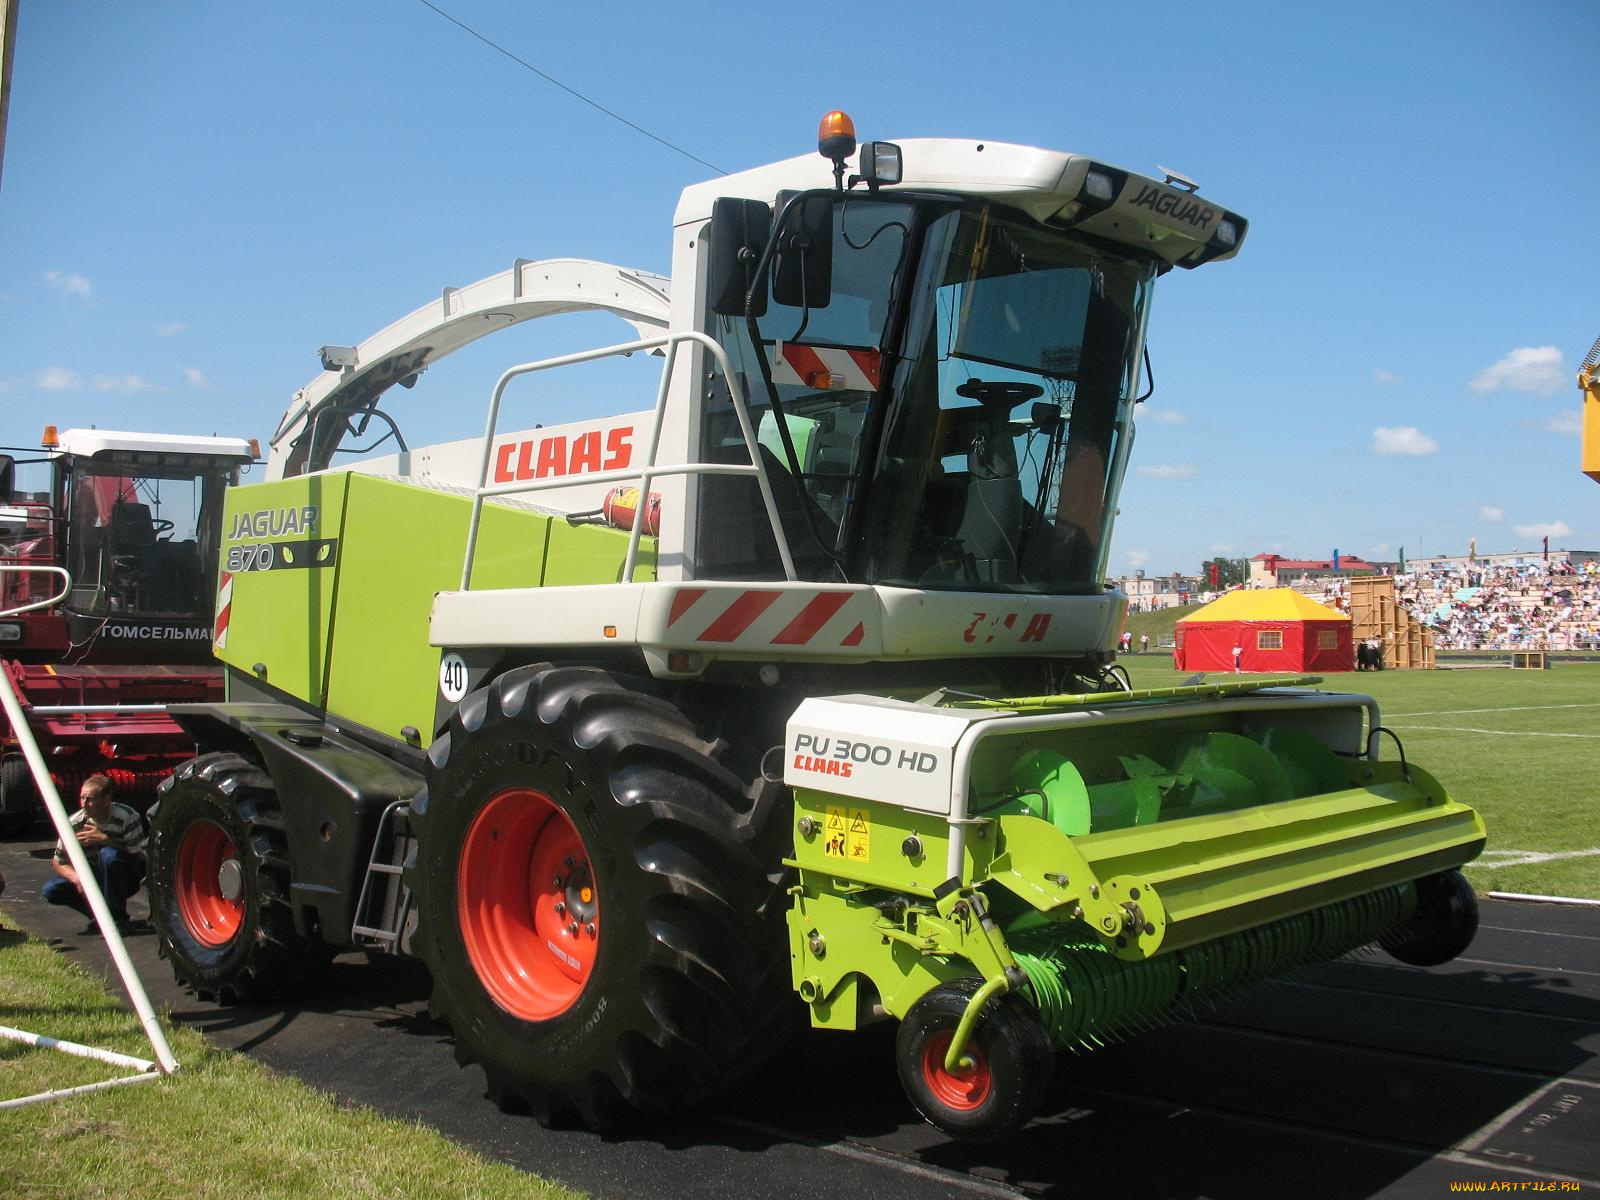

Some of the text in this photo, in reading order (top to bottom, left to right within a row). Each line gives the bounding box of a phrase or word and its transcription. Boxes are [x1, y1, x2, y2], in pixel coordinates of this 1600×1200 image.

[1128, 184, 1215, 229] JAGUAR
[494, 426, 634, 483] CLAAS
[227, 505, 319, 540] JAGUAR
[227, 543, 274, 573] 870
[101, 625, 214, 640] ГОМСЕЛЬМА
[444, 661, 463, 691] 40
[793, 754, 854, 778] CLAAS
[794, 733, 938, 774] PU 300 HD
